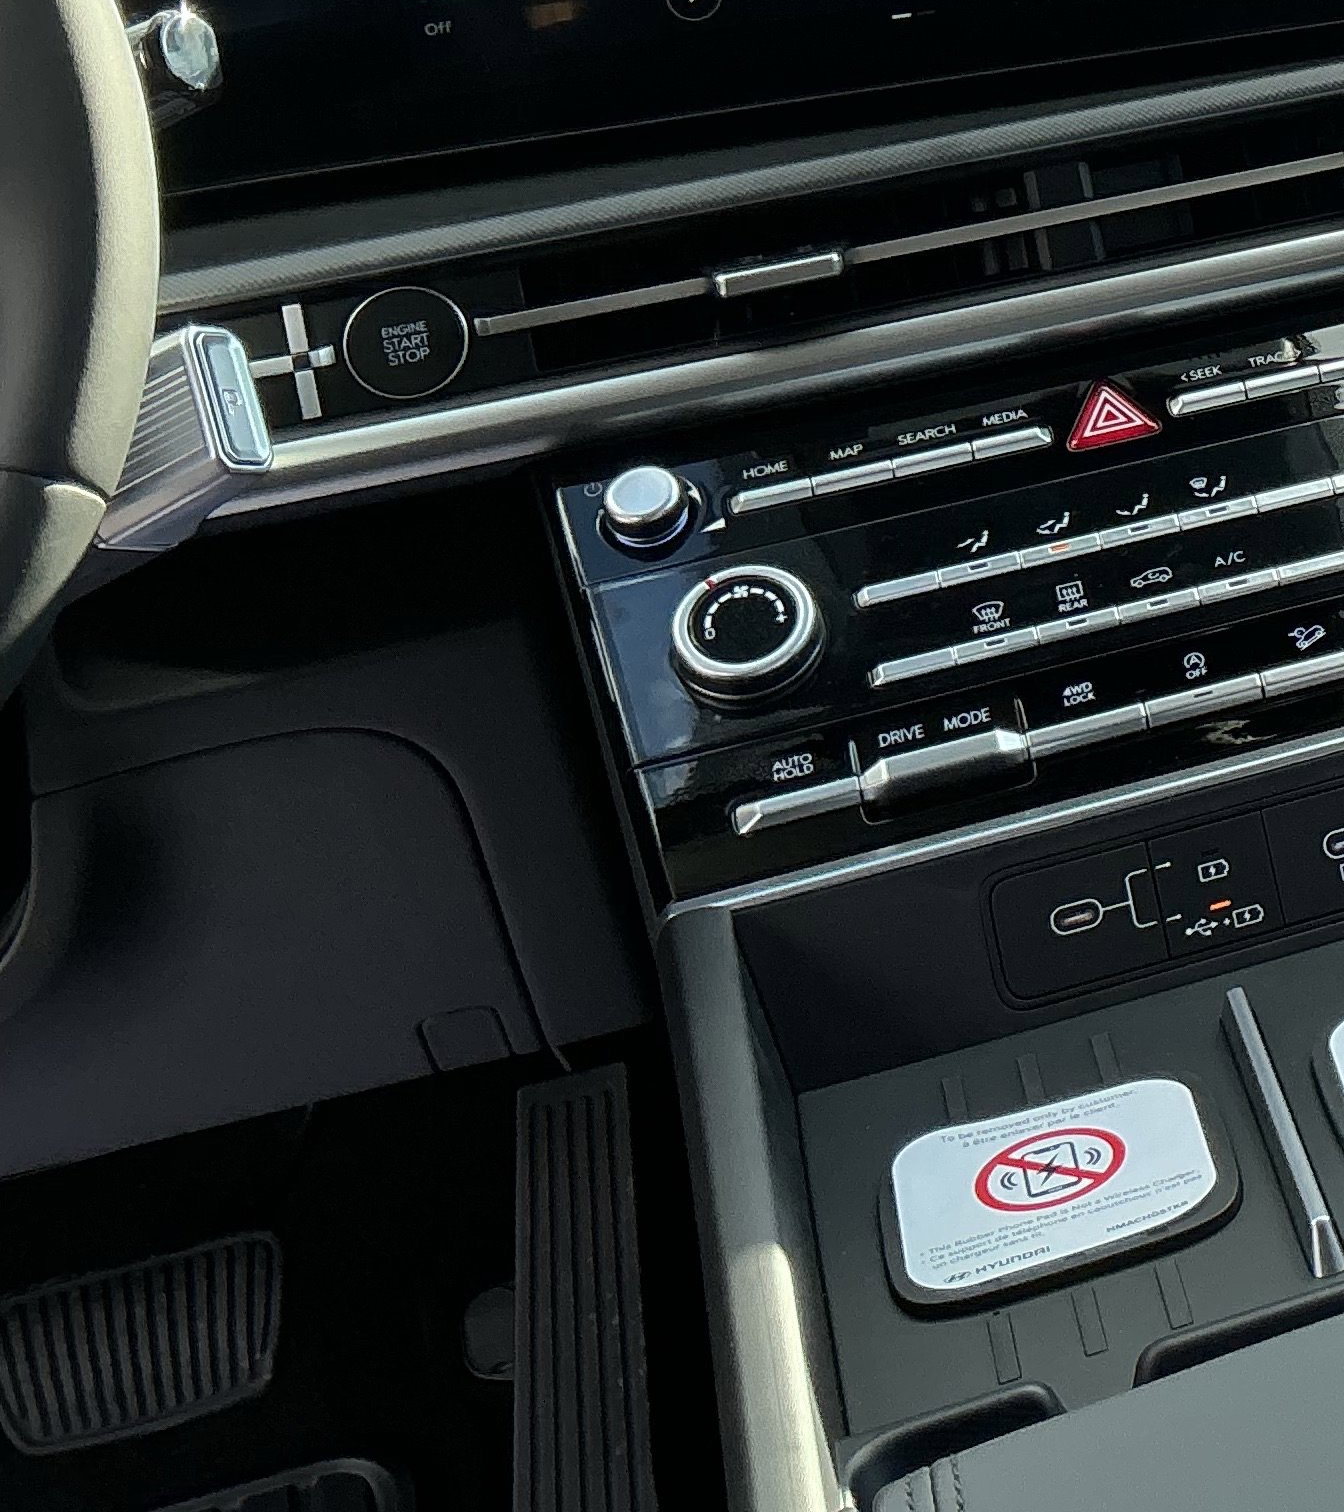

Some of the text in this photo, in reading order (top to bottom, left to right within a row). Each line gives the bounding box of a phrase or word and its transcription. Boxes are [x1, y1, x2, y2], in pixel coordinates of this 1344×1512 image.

[424, 20, 453, 37] Off
[381, 320, 427, 339] ENGINE
[383, 332, 429, 353] START
[388, 347, 430, 367] STOP
[1189, 364, 1222, 381] SEEK
[742, 408, 1028, 480] HOME MAP SEARCH MEDIA
[1214, 550, 1247, 568] A/C
[1057, 597, 1089, 613] REAR
[972, 617, 1012, 635] FRONT
[1185, 667, 1208, 680] OFF
[1062, 680, 1094, 697] 4WD
[1063, 691, 1096, 708] LOCK
[878, 707, 992, 748] DRIVE MODE
[772, 752, 814, 772] AUTO
[773, 761, 815, 783] HOLD
[975, 1245, 1050, 1274] HYUNDAI
